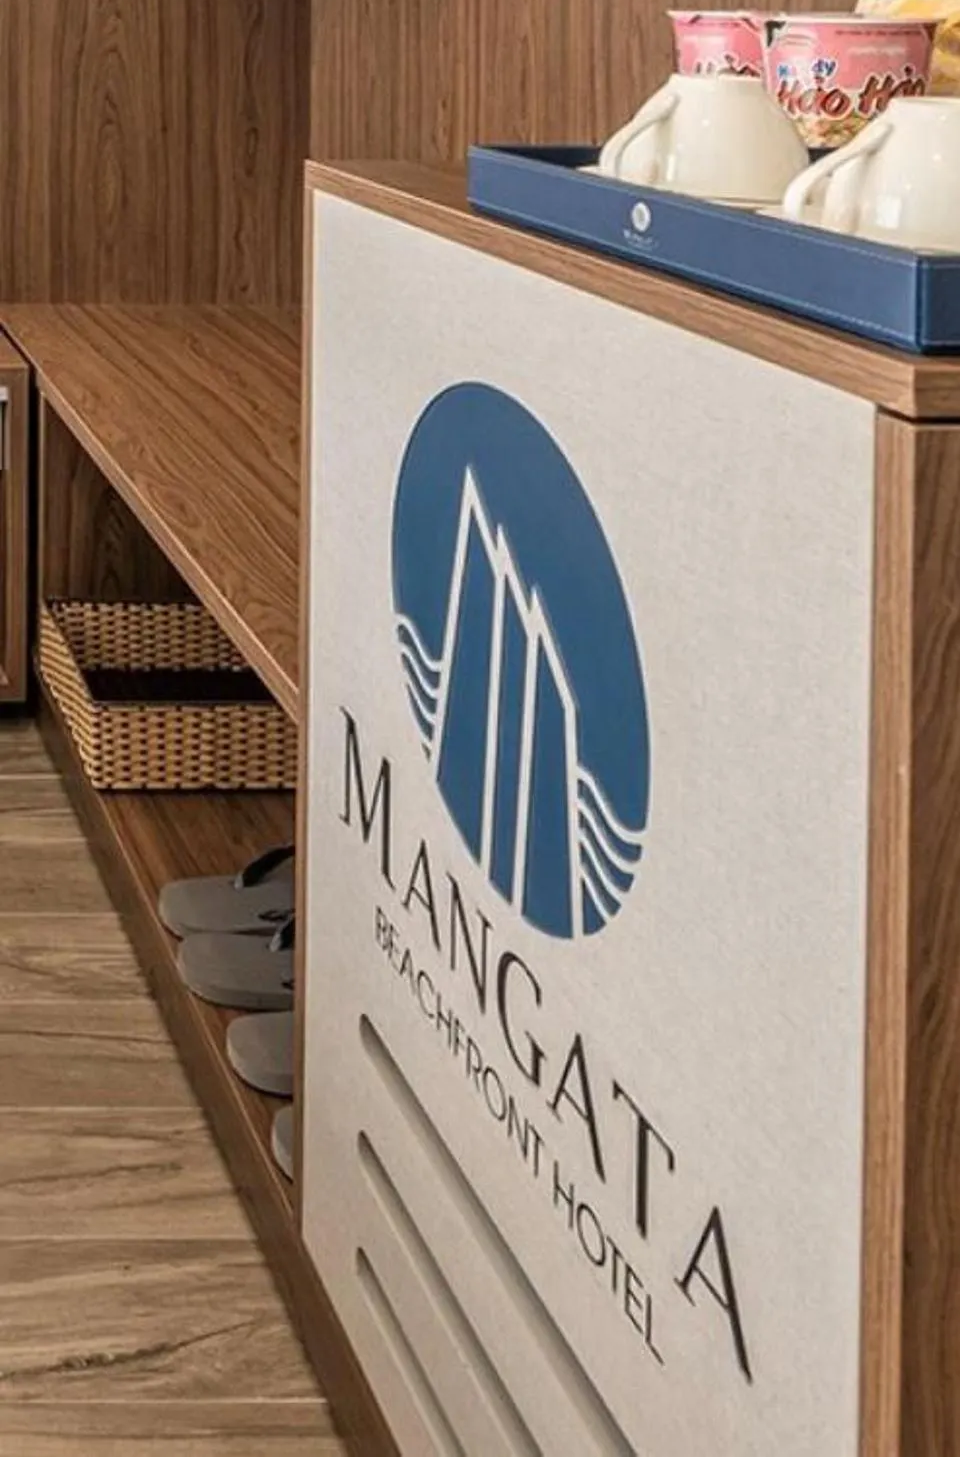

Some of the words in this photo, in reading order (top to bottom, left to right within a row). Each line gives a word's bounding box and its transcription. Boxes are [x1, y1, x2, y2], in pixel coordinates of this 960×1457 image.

[339, 706, 752, 1385] MANGATA
[375, 906, 546, 1179] BEACHFRONT
[552, 1160, 664, 1366] HOTEL
